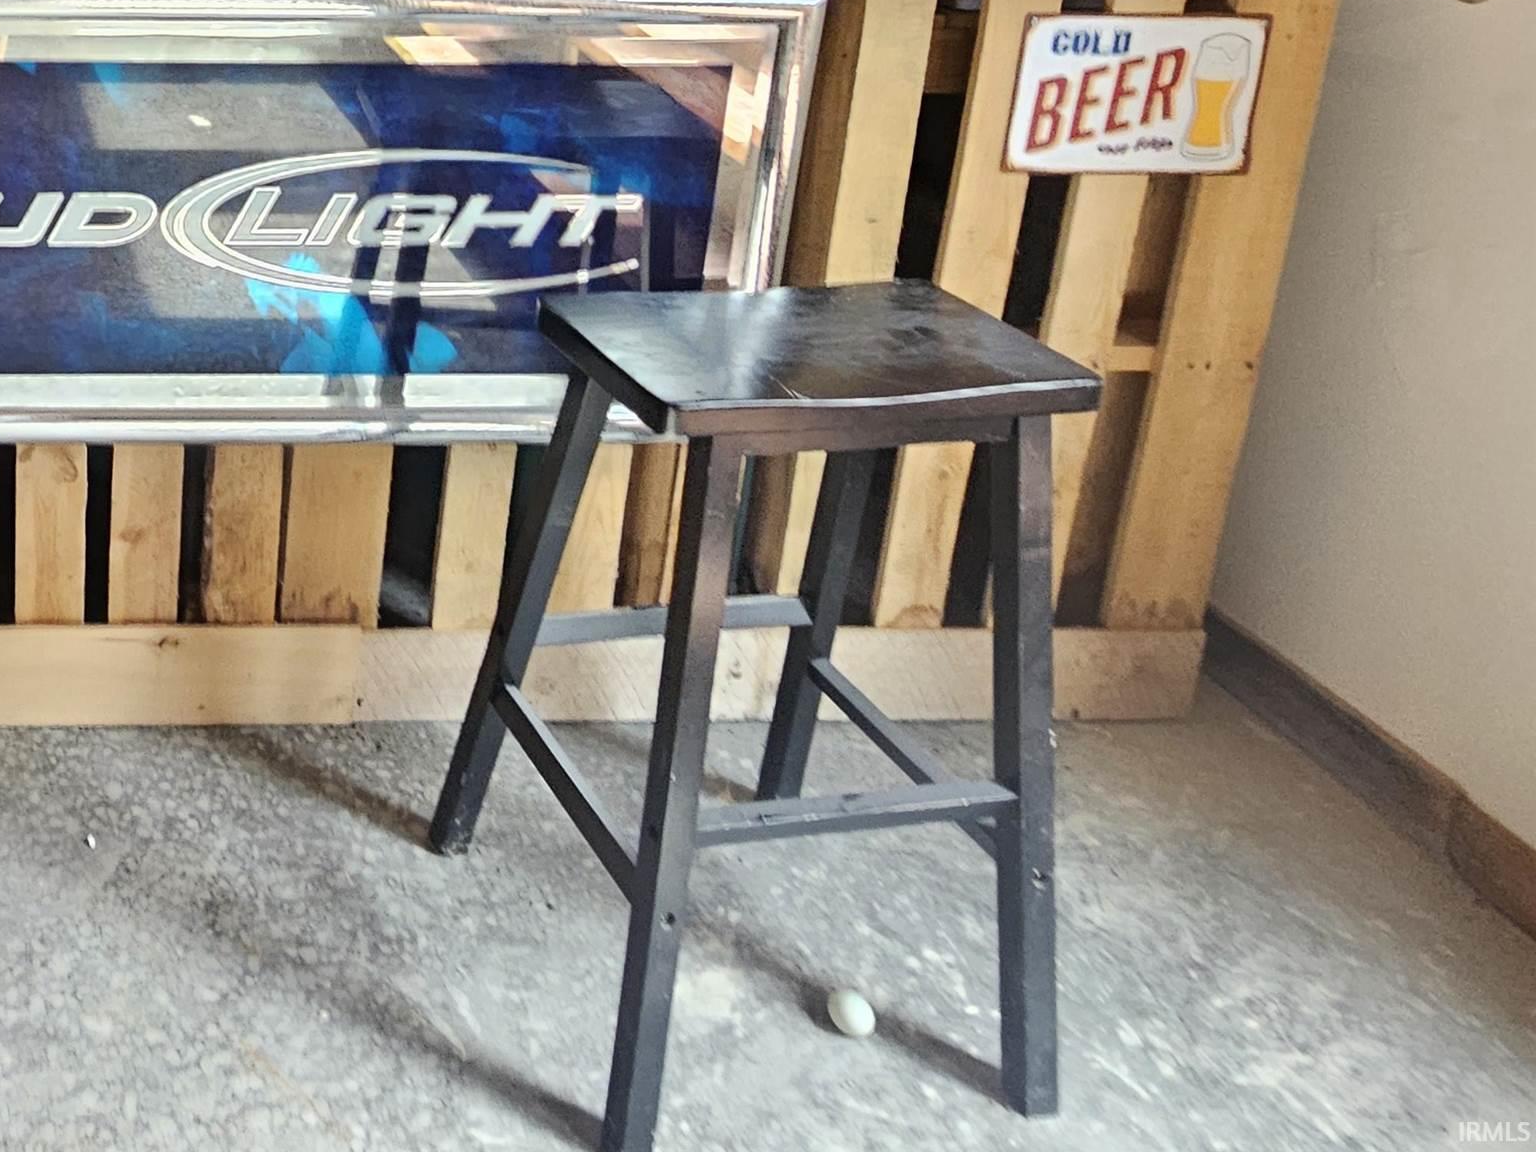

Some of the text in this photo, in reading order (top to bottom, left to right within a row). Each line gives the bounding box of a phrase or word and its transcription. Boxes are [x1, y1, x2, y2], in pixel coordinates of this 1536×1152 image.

[1051, 29, 1133, 56] COLD
[1025, 47, 1187, 153] BEER
[222, 185, 642, 248] LIGHT
